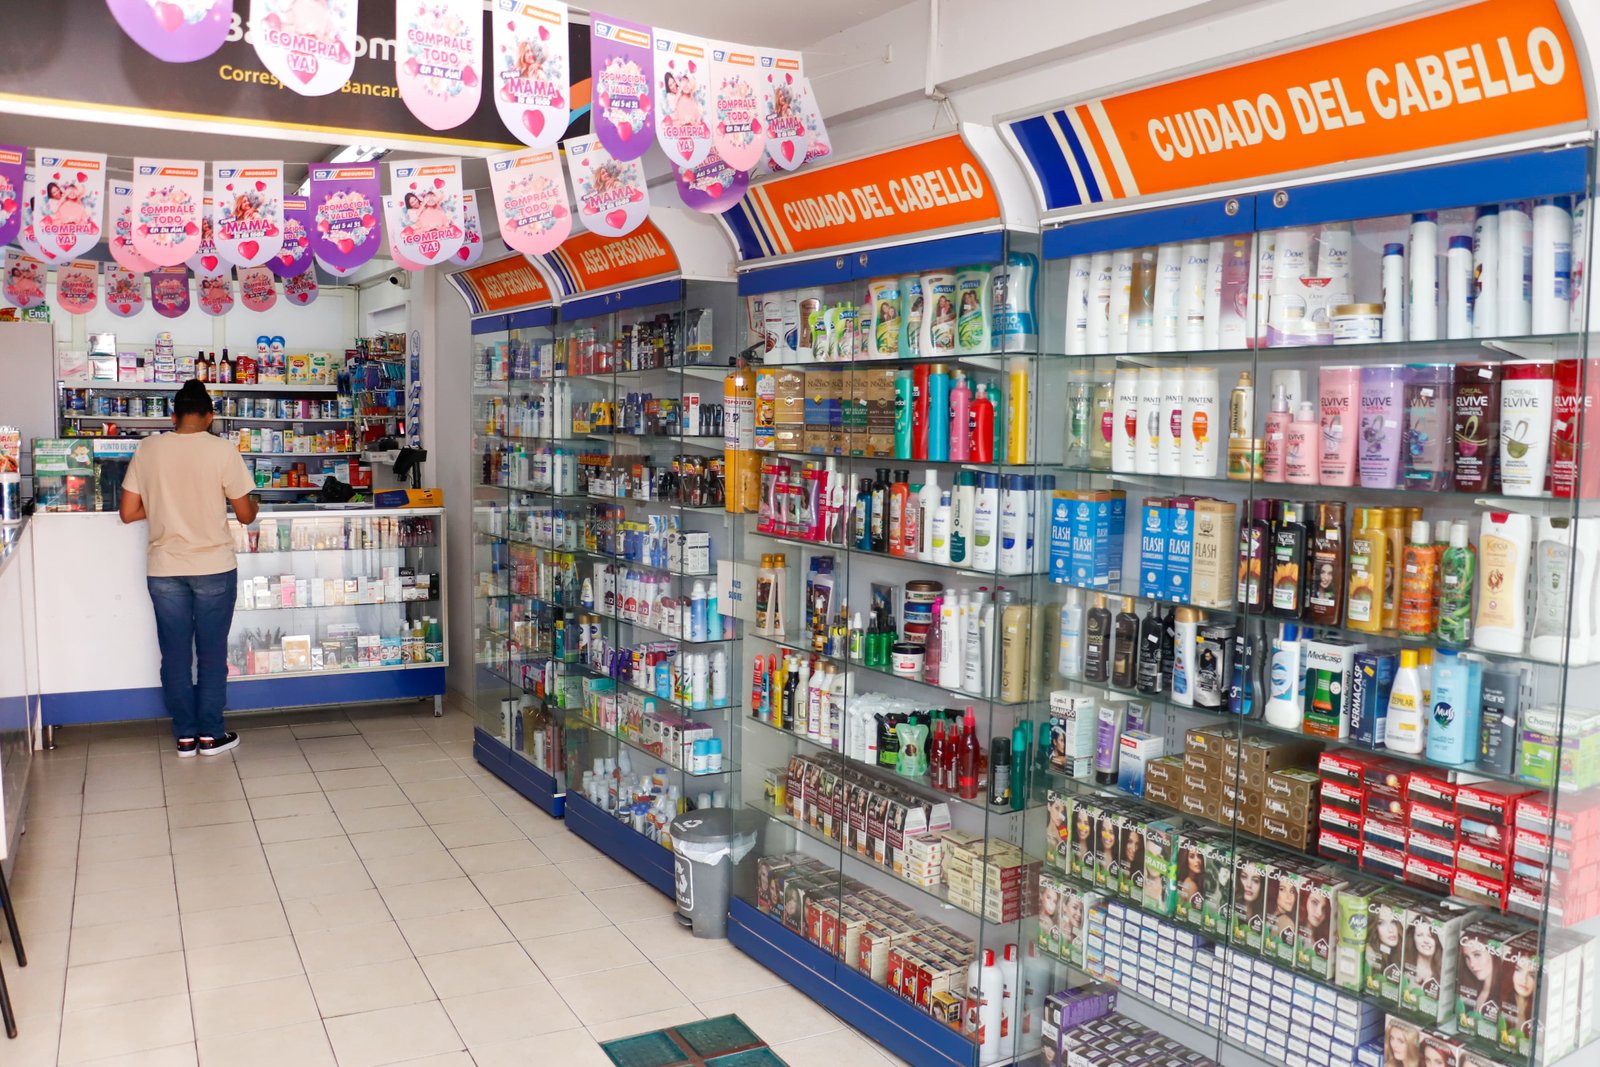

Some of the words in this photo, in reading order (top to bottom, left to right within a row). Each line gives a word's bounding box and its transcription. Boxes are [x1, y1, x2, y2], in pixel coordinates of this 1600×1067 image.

[407, 28, 473, 52] COMPRALE
[423, 47, 459, 65] TODO
[289, 53, 316, 74] YA!
[510, 77, 556, 98] MAMA
[1146, 92, 1287, 163] CUIDADO
[1286, 77, 1366, 137] DEL
[1366, 25, 1566, 121] CABELLO
[717, 99, 756, 109] COMPRALE
[727, 112, 749, 122] TODO
[771, 117, 799, 131] MAMA
[678, 139, 694, 153] YA!
[504, 187, 559, 209] COMPRALE
[590, 185, 634, 206] MAMA
[783, 190, 856, 233] CUIDADO
[851, 181, 895, 219] DEL
[888, 162, 984, 214] CABELLO
[140, 205, 195, 215] COMPRALE
[319, 201, 370, 212] PROMOCION
[518, 202, 548, 216] TODO
[153, 215, 182, 224] TODO
[330, 211, 360, 221] VALIDA
[42, 224, 90, 234] ¡COMPRA
[226, 219, 271, 233] MAMA
[58, 235, 75, 245] YA!
[403, 229, 454, 244] ¡COMPRA
[420, 242, 439, 253] YA!
[583, 248, 607, 272] ASEO
[608, 231, 666, 269] PERSONAL
[1284, 250, 1304, 258] Dove
[1328, 248, 1348, 258] Dove
[1187, 255, 1209, 266] Dove
[485, 276, 501, 299] ASEO
[501, 264, 543, 297] PERSONAL
[1187, 396, 1214, 404] PANTENE
[1321, 397, 1349, 407] ELVIVE
[1361, 396, 1392, 407] ELVIVE
[1456, 395, 1488, 407] ELVIVE
[1503, 397, 1539, 407] ELVIVE
[100, 442, 119, 450] PUNTO
[1052, 525, 1070, 541] FLASH
[1073, 536, 1093, 552] FLASH
[1142, 536, 1164, 553] FLASH
[1168, 538, 1191, 556] FLASH
[1194, 542, 1217, 560] FLASH
[1307, 650, 1342, 664] Medicasp
[1350, 664, 1364, 729] DERMACASP
[1483, 692, 1506, 704] vitane
[1050, 704, 1077, 718] SHAMPOO
[1267, 777, 1291, 797] Magendy
[1264, 818, 1288, 838] Magendy
